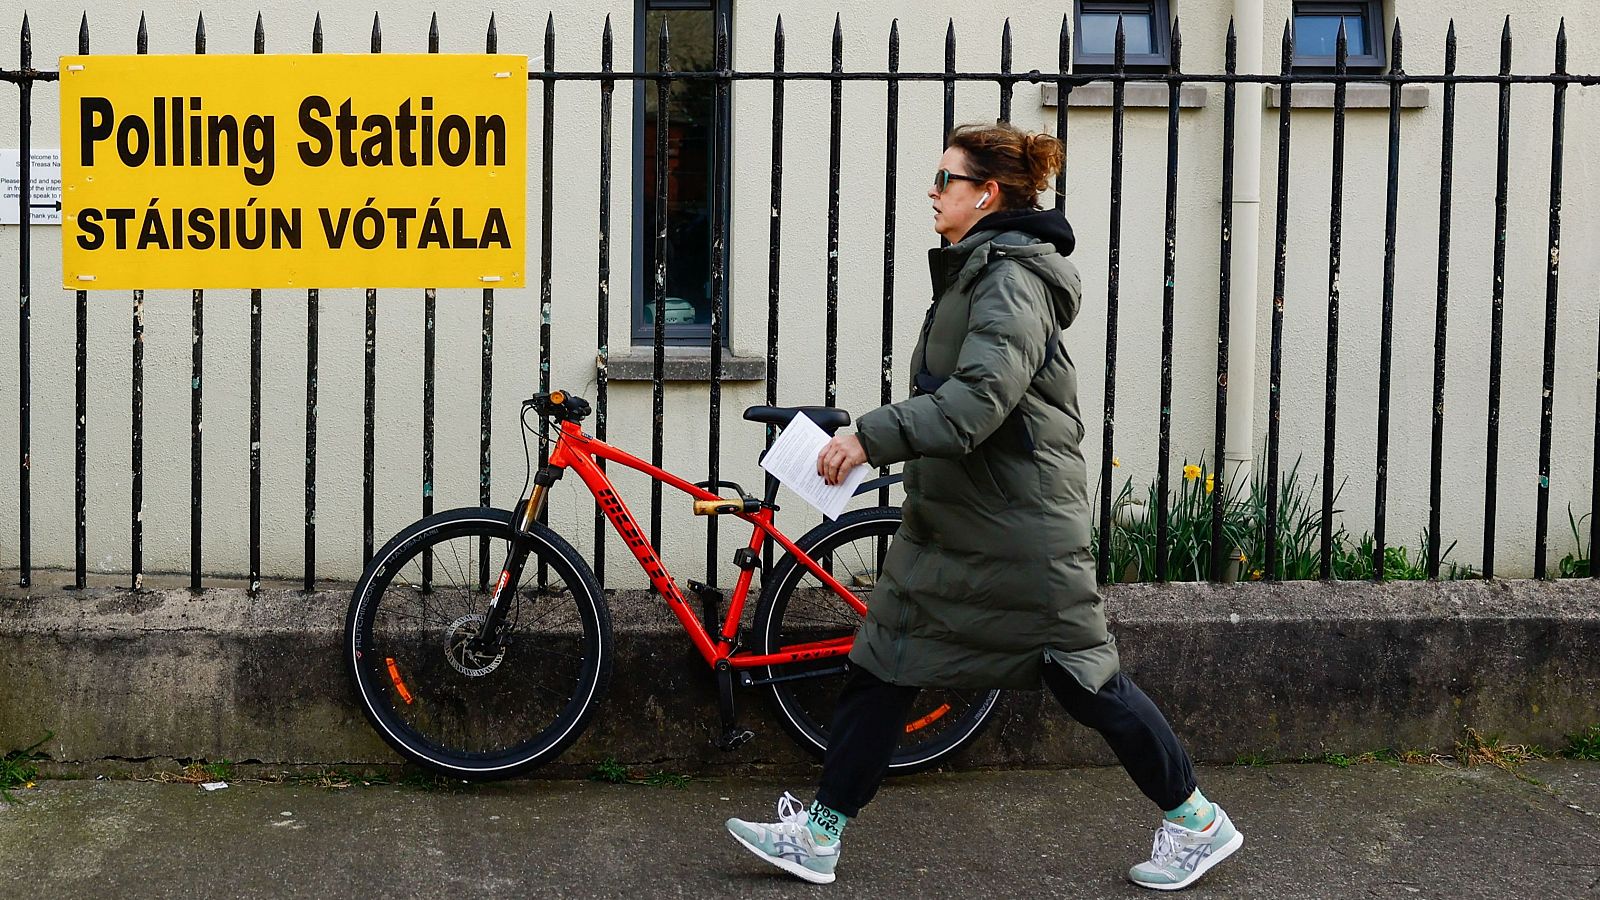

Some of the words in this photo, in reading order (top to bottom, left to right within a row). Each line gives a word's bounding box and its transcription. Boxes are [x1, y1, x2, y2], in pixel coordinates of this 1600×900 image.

[81, 96, 274, 187] Polling
[298, 95, 506, 168] Station
[77, 197, 302, 251] STÁISIÚN
[319, 197, 511, 250] VÓTÁLA
[354, 581, 377, 648] HUTCHINSON
